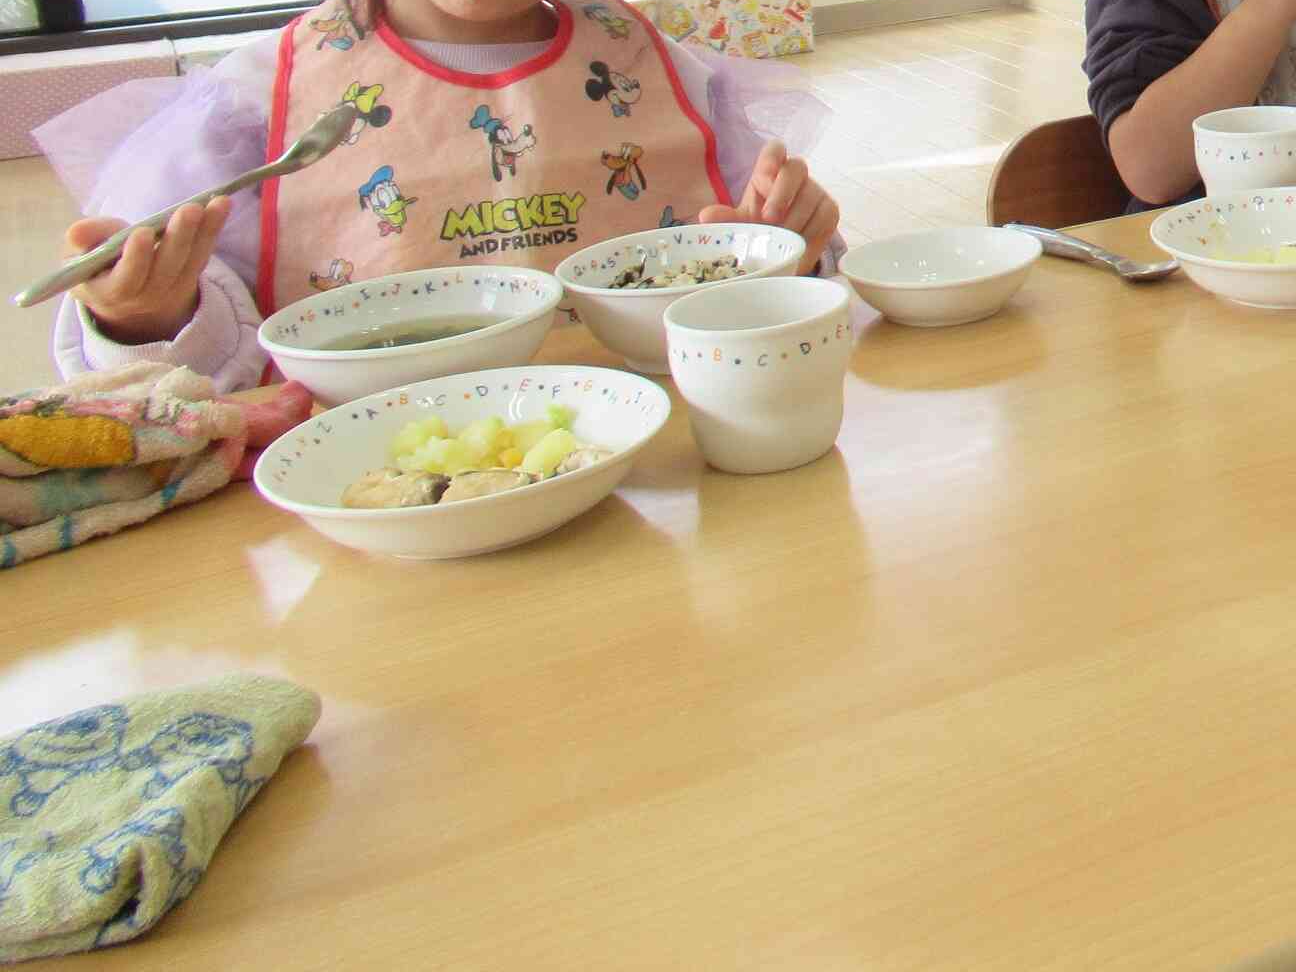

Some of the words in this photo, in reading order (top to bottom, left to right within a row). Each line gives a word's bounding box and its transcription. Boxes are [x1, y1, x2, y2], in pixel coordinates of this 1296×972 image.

[440, 191, 586, 241] MICKEY
[459, 239, 499, 259] AND
[500, 228, 577, 252] FRIENDS
